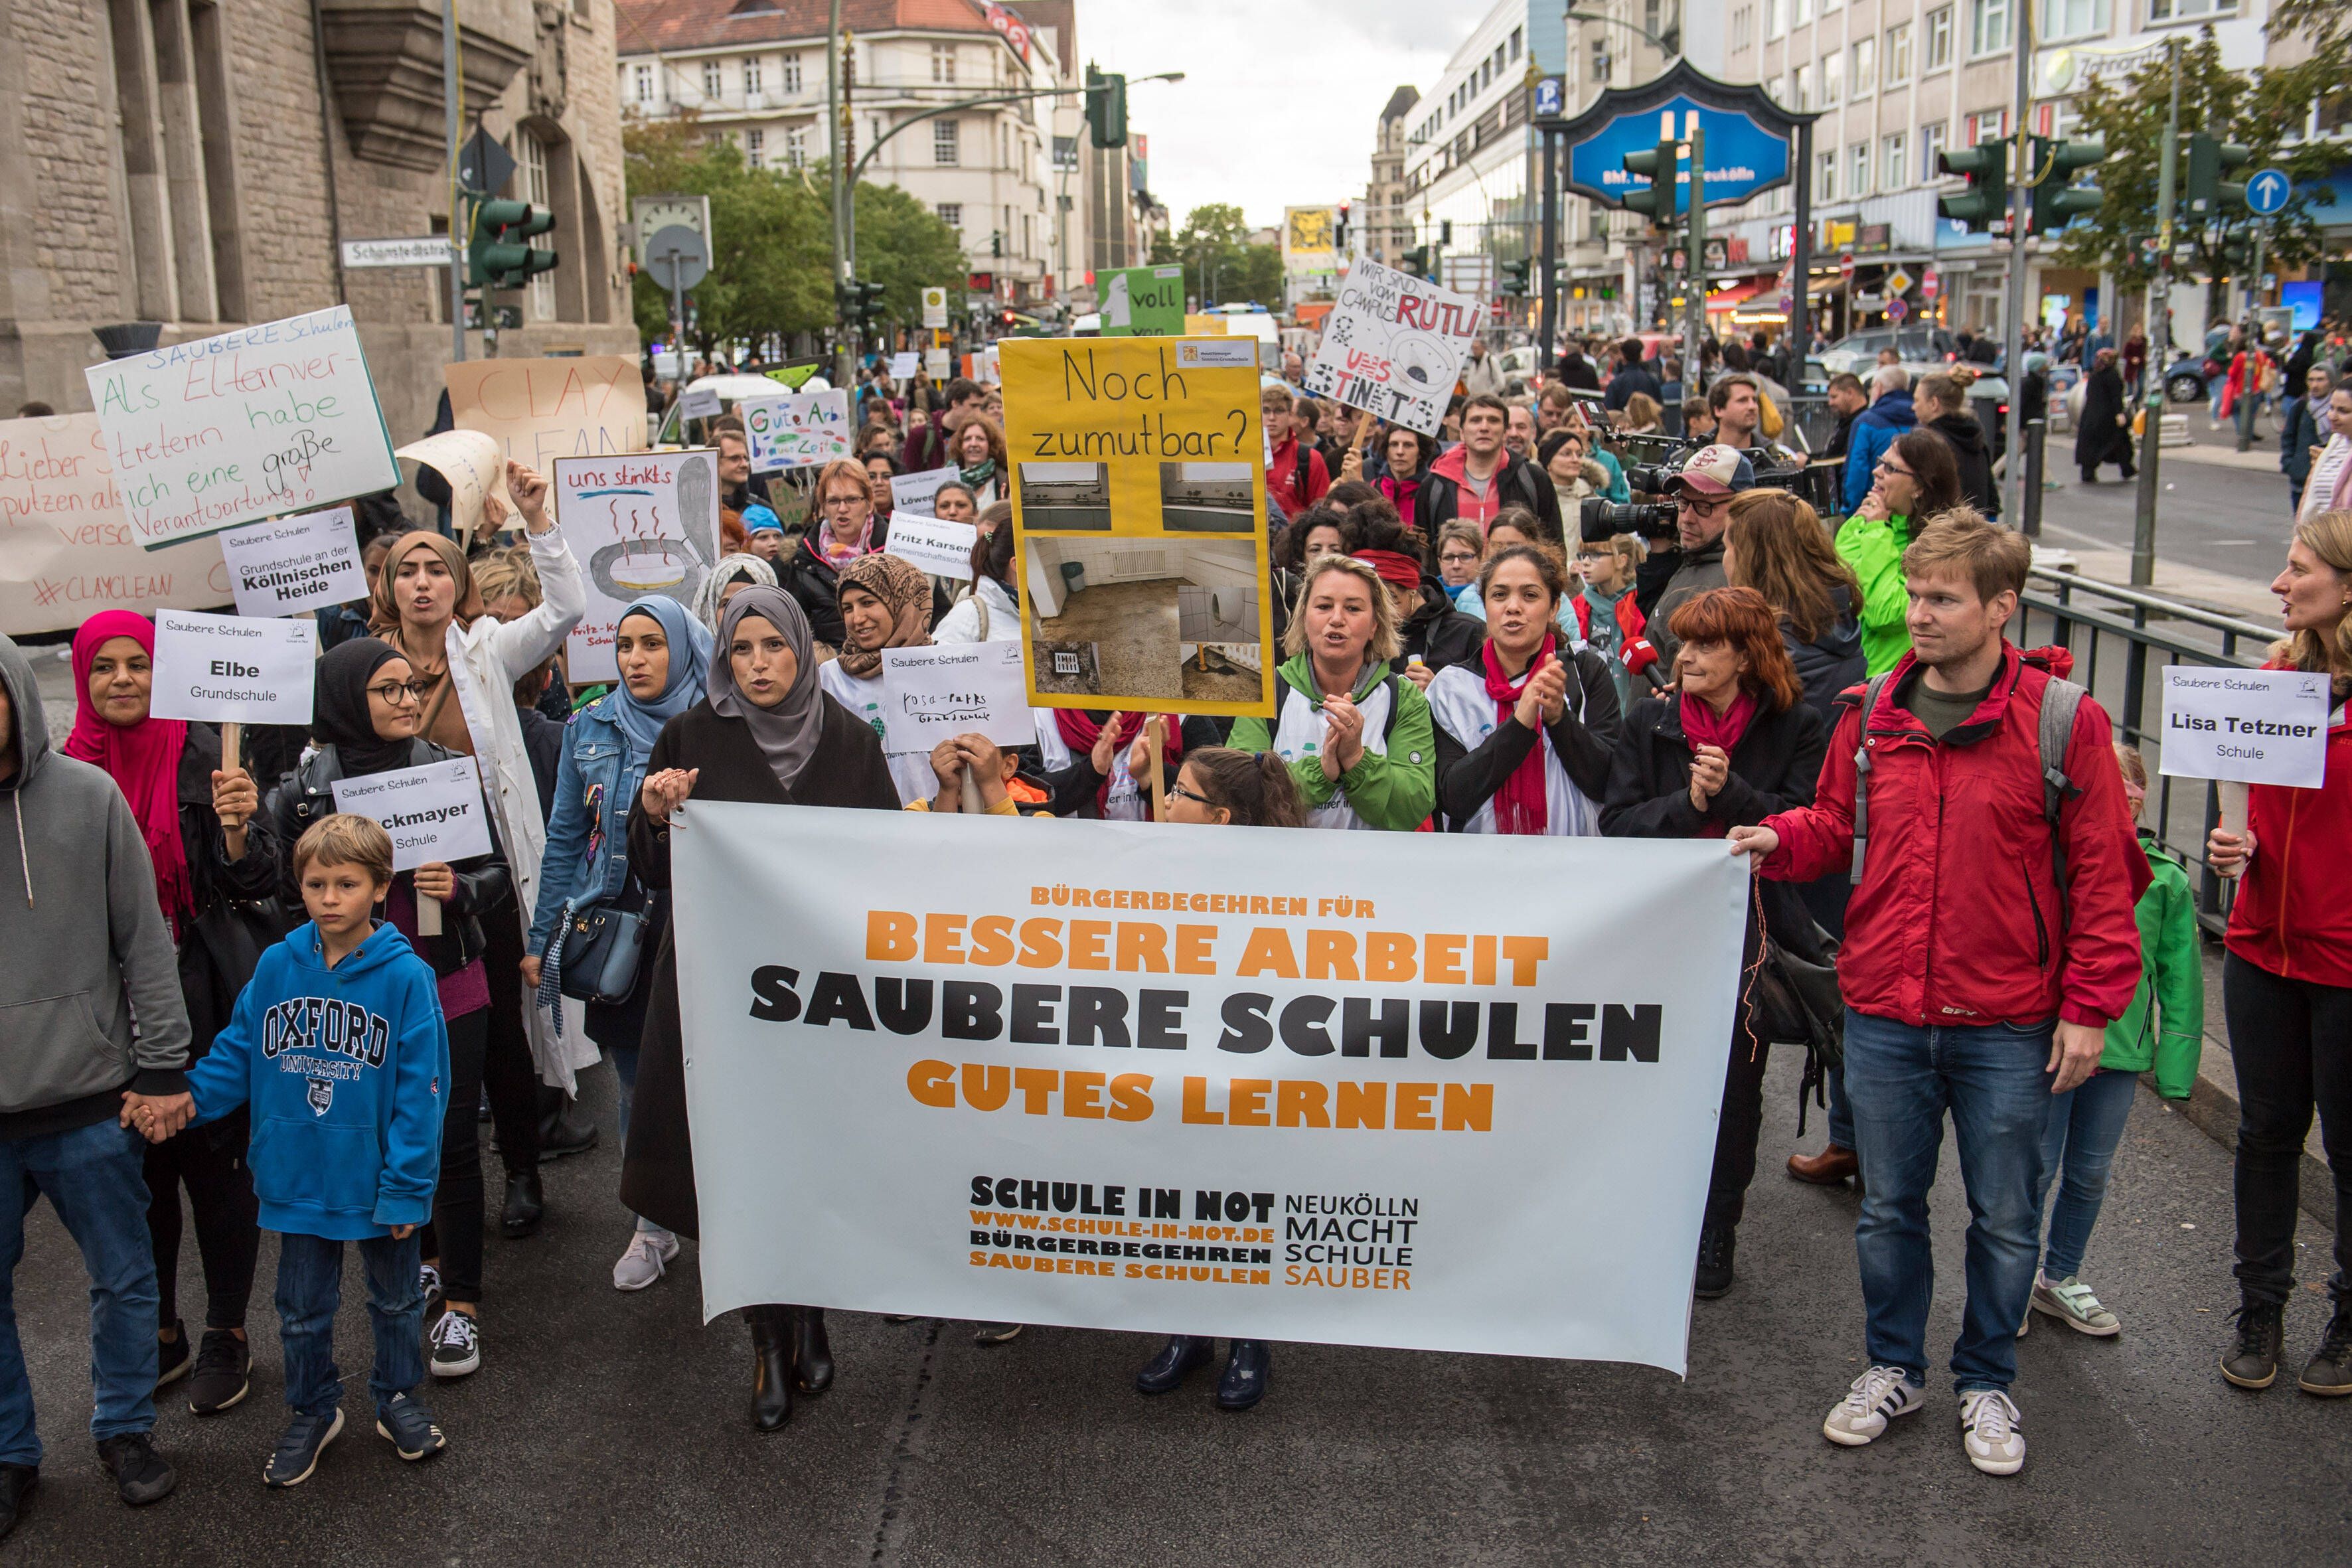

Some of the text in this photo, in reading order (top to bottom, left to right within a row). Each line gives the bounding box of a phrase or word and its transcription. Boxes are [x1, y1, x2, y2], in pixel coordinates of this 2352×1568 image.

[1703, 167, 1755, 182] eukölln
[1360, 261, 1418, 293] WIR SIND
[1133, 285, 1176, 308] voll
[1370, 281, 1396, 301] VOM
[1342, 289, 1398, 322] CAMPUS
[147, 312, 354, 369] SAUBERE Schulen
[1063, 346, 1188, 401] Noch
[1346, 348, 1391, 382] UNS
[478, 364, 625, 421] CLAY
[245, 390, 345, 430] habe
[749, 408, 802, 433] Gute
[1033, 409, 1248, 457] zumutbar?
[0, 437, 86, 481] Lieber
[128, 429, 341, 510] ich eine große
[568, 463, 672, 488] uns stinkt's
[4, 484, 83, 528] putzen
[901, 495, 935, 506] Löwen
[229, 526, 311, 548] Saubere Schulen
[894, 532, 971, 554] Fritz Karsen
[240, 546, 349, 576] Grundschule an der
[889, 544, 970, 565] Gemeinschaftsschul
[242, 559, 353, 591] Köllnischen
[34, 573, 173, 607] #CLAYCLEAN
[276, 580, 329, 601] Heide
[166, 620, 262, 638] Saubere Schulen
[586, 635, 616, 647] Schul
[210, 660, 260, 678] Elbe
[891, 654, 979, 668] Saubere Schulen
[190, 686, 277, 702] Grundschule
[2172, 675, 2270, 692] Saubere Schulen
[2171, 712, 2317, 738] Lisa Tetzner
[2217, 744, 2264, 759] Schule
[341, 776, 428, 799] Saubere Schulen
[377, 803, 469, 830] ckmayer
[396, 833, 438, 850] Schule
[1031, 884, 1375, 919] BÜRGERBEGEHREN FÜR
[866, 911, 1549, 986] BESSERE ARBEIT
[749, 965, 1663, 1063] SAUBERE SCHULEN
[262, 996, 390, 1069] OXFORD
[279, 1054, 364, 1081] UNIVERSITY
[906, 1059, 1494, 1132] GUTES LERNEN
[970, 1175, 1275, 1223] SCHULE IN NOT
[1285, 1192, 1419, 1217] NEUKÖLLN
[969, 1210, 1275, 1243] WWW.SCHULE-IN-NOT.DE
[1285, 1217, 1419, 1245] MACHT
[970, 1229, 1271, 1264] BÜRGERBEGEHREN
[1285, 1243, 1413, 1267] SCHULE
[969, 1251, 1271, 1285] SAUBERE SCHULEN
[1285, 1265, 1412, 1291] SAUBER
